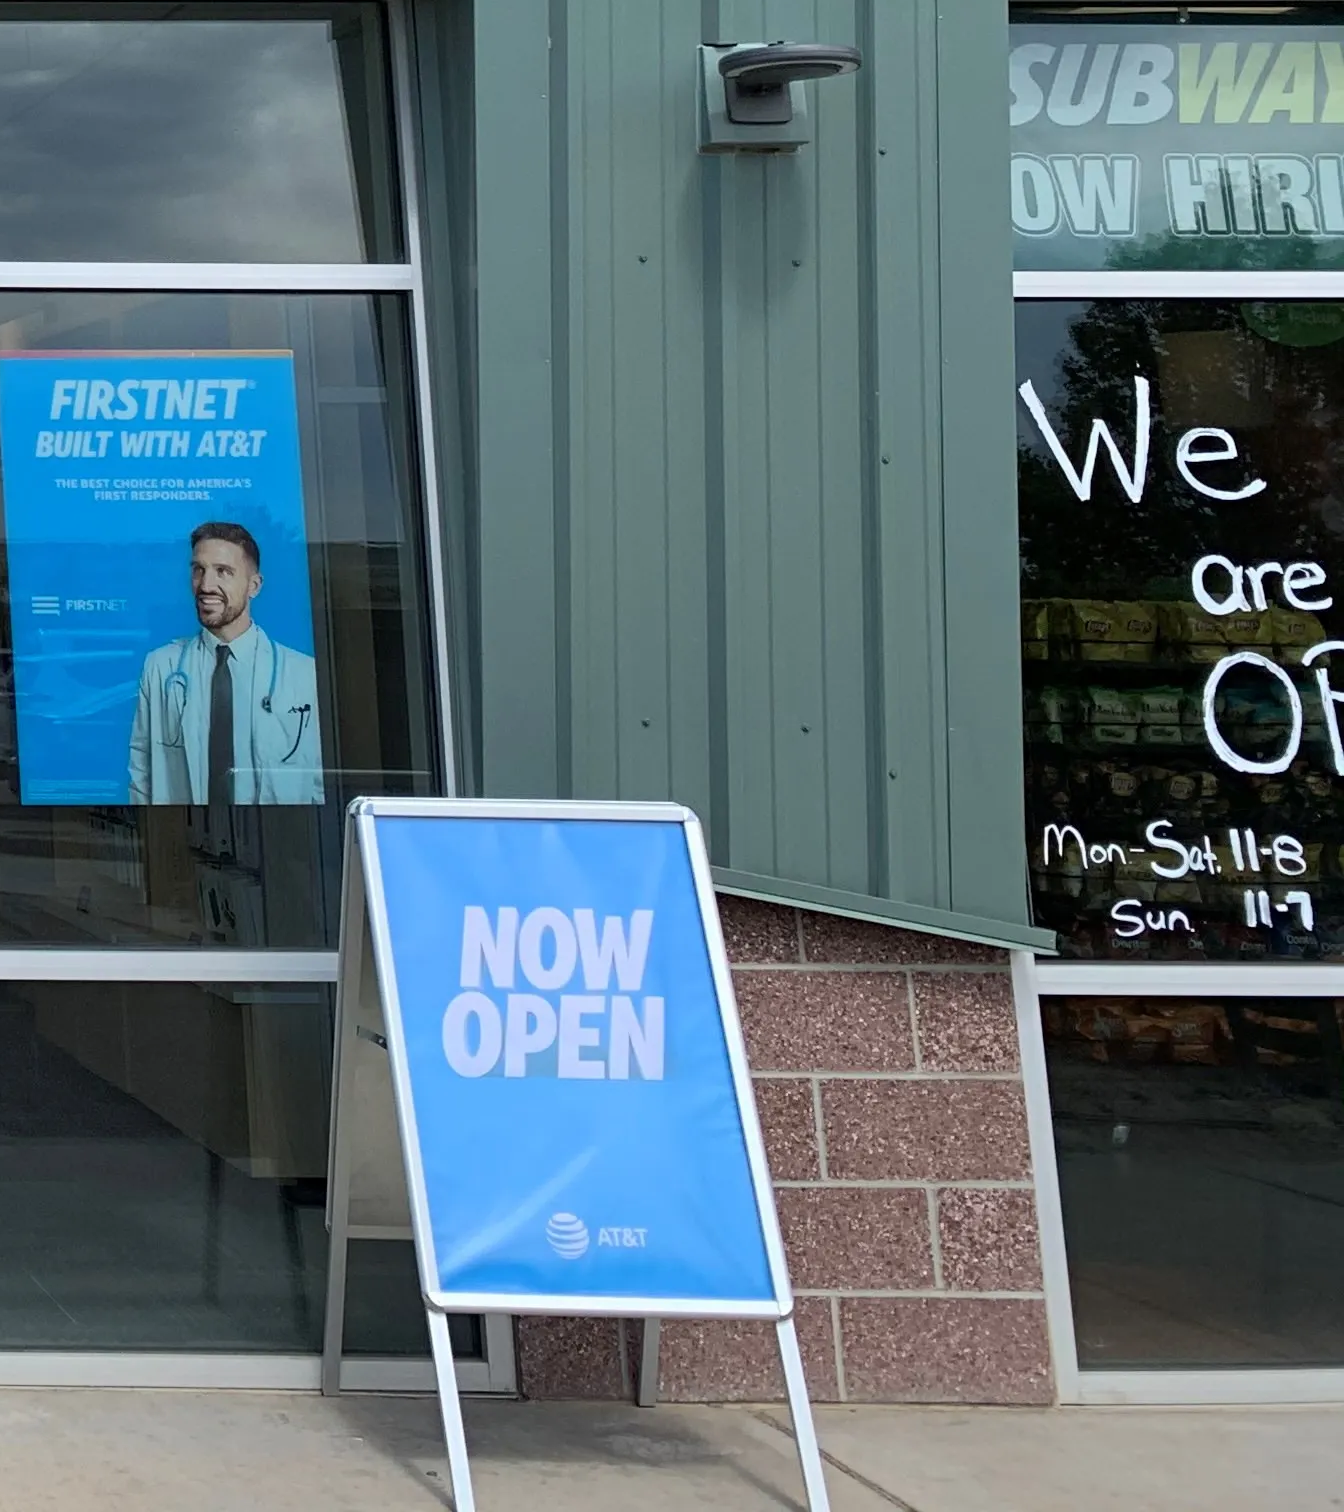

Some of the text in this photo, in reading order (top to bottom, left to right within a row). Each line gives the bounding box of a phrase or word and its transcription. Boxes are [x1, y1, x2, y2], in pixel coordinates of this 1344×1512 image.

[35, 430, 267, 458] BUILT WITH AT&T
[1019, 372, 1267, 504] We
[55, 478, 252, 489] THE BEST CHOICE FOR AMERICA'S
[94, 490, 213, 501] FIRST RESPONDERS.
[1191, 554, 1333, 616] are
[460, 905, 654, 992] NOW
[442, 990, 665, 1081] OPEN
[597, 1227, 648, 1249] AT&T
